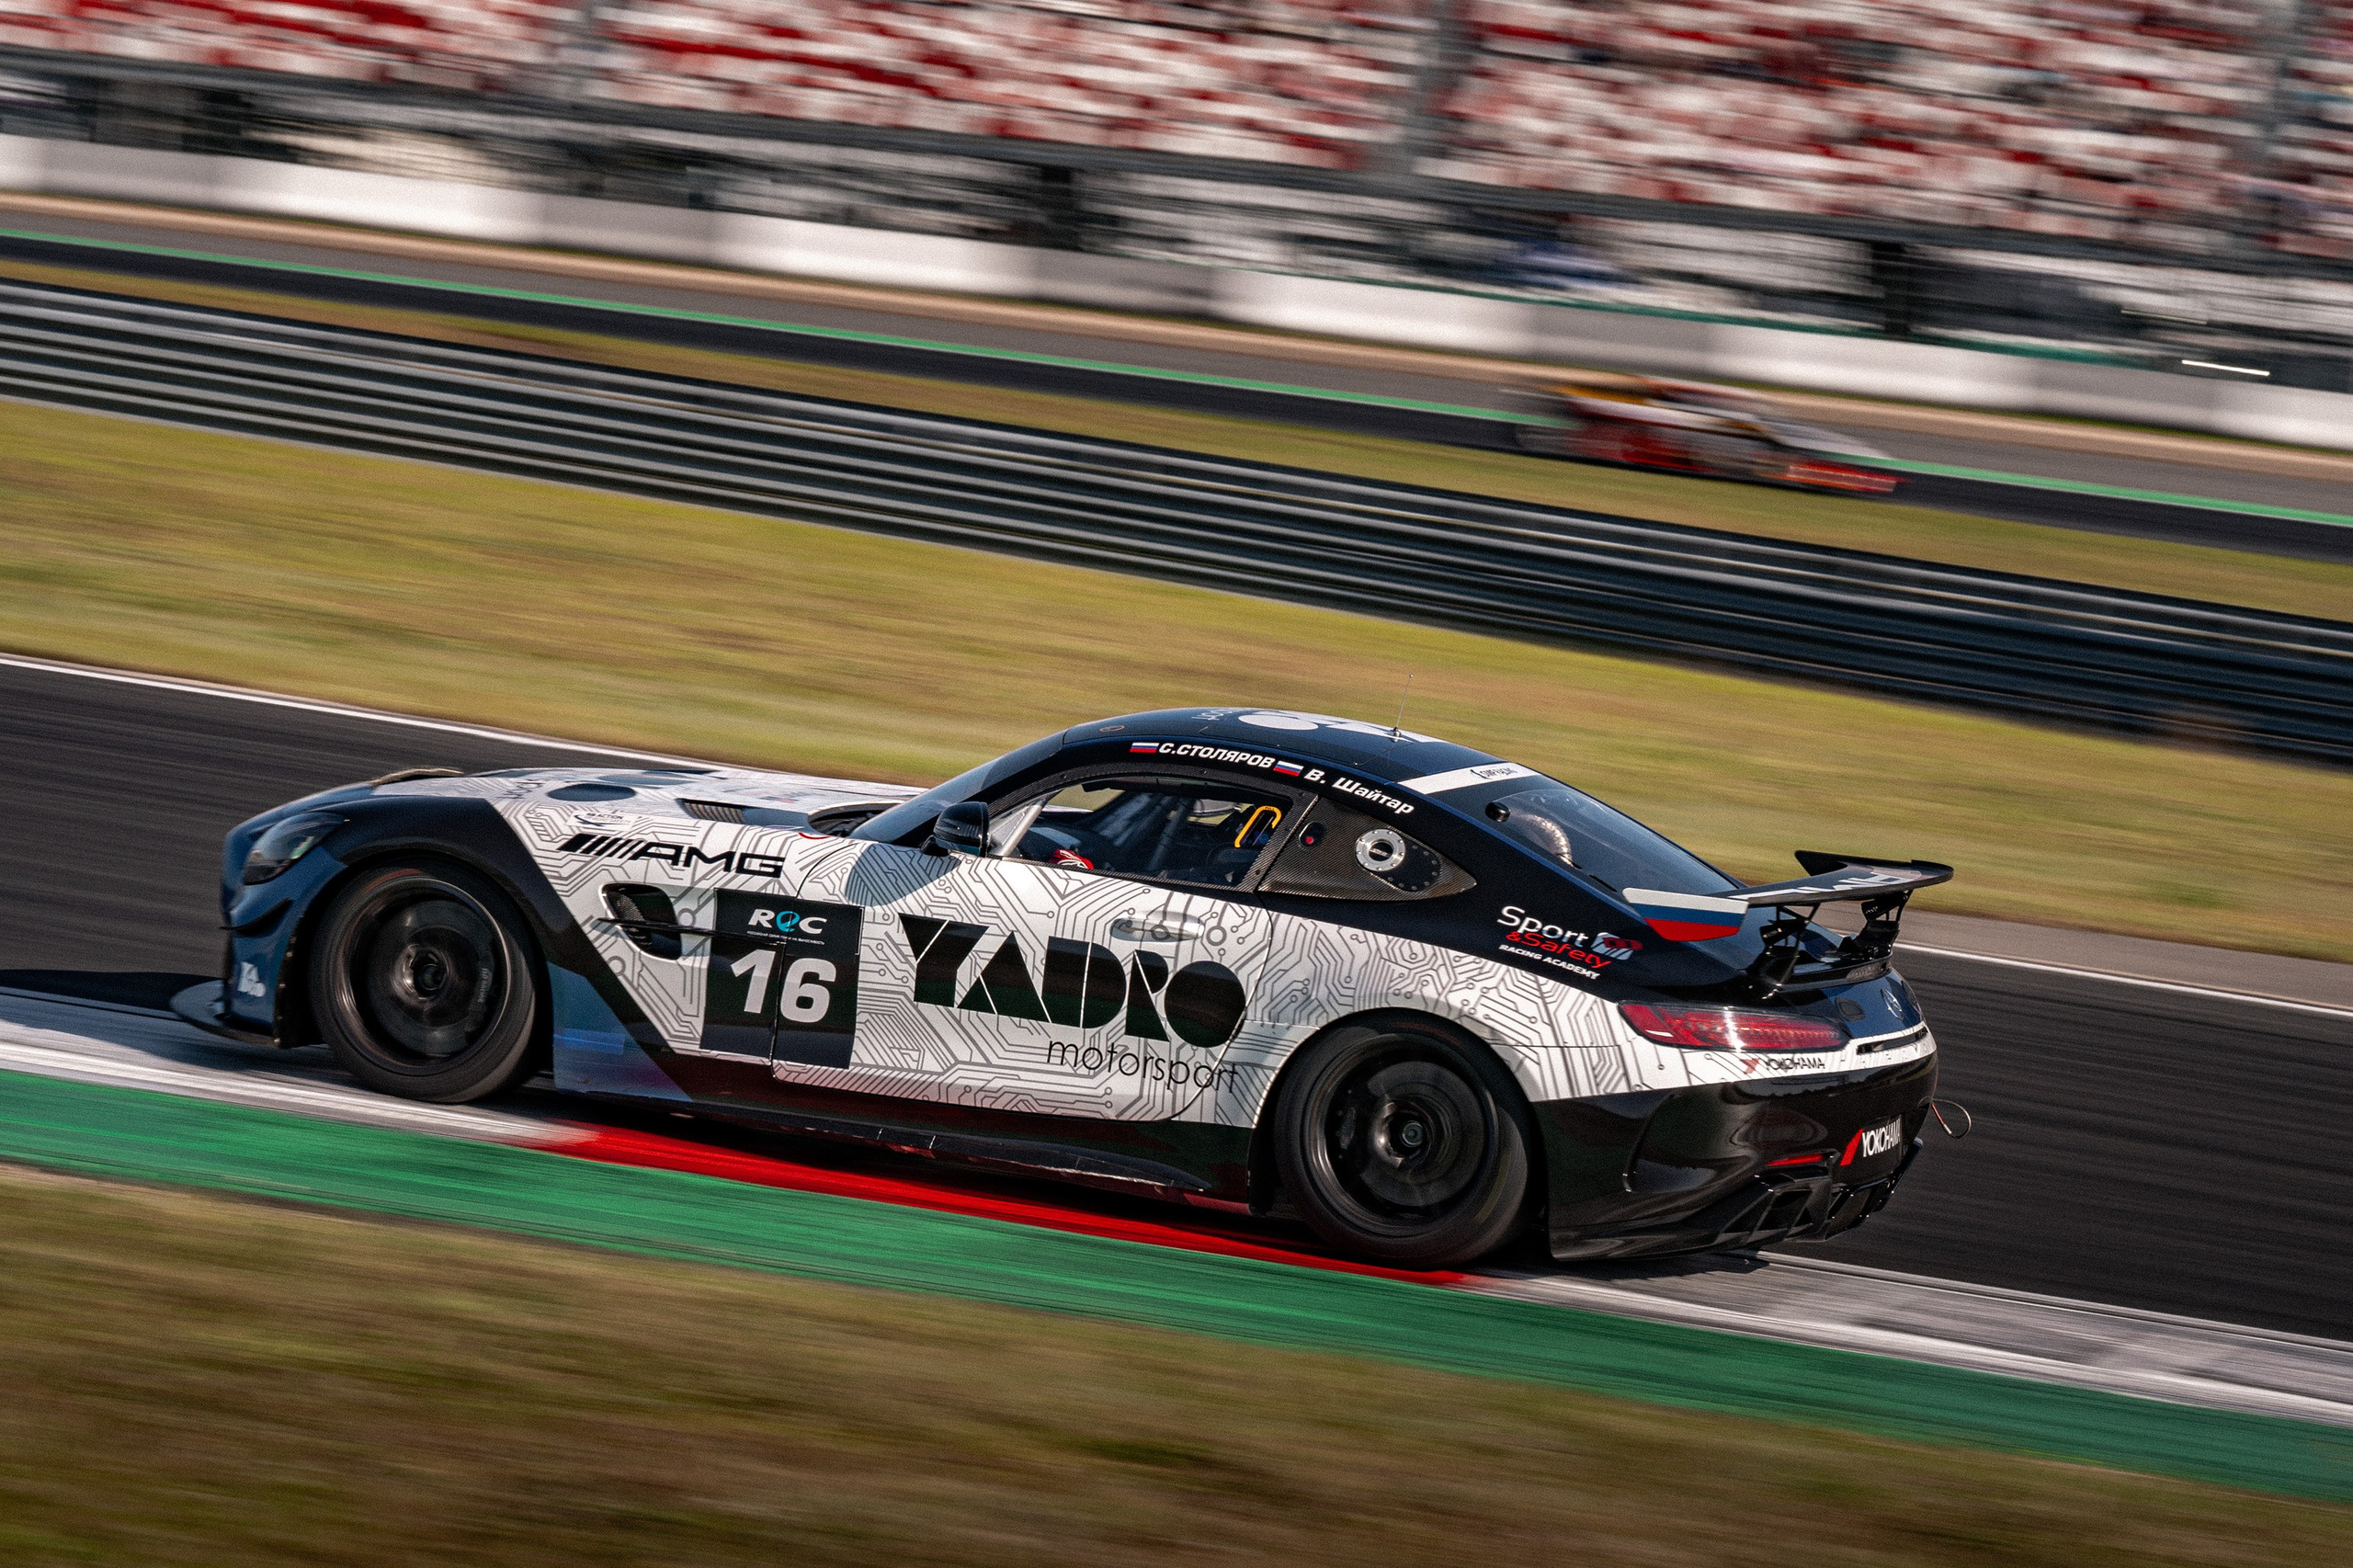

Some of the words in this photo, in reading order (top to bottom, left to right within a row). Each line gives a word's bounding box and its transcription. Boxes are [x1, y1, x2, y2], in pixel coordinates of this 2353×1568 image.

[1158, 743, 1276, 768] С.СТОЛЯРОВ
[1303, 768, 1326, 784] В.
[1331, 777, 1415, 815] Шайтар
[628, 841, 786, 879] AMG
[1496, 905, 1589, 948] Sport
[897, 913, 1246, 1048] YADRO
[1498, 944, 1543, 960] RACING
[1542, 957, 1601, 981] ACADEMY
[730, 949, 837, 1023] 16
[1047, 1040, 1238, 1094] motorsport
[1765, 1057, 1825, 1072] YOKOHAMA
